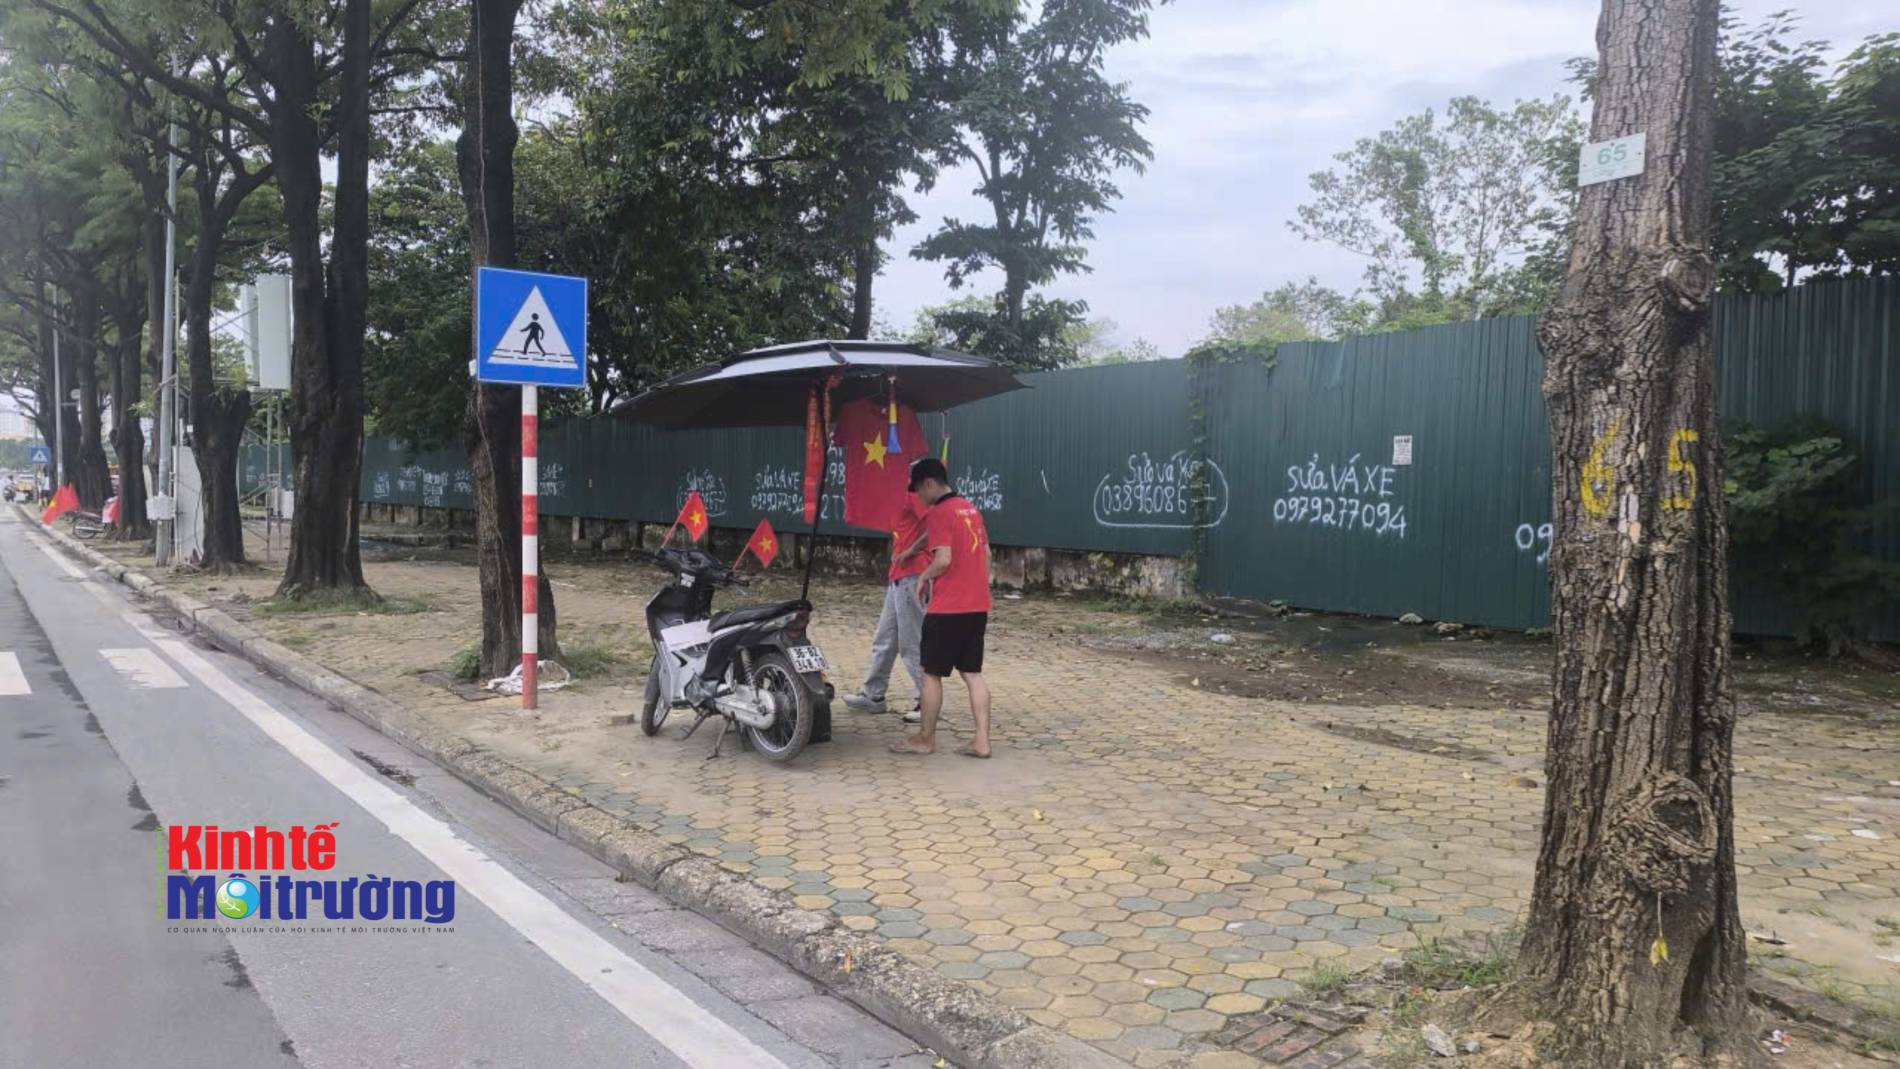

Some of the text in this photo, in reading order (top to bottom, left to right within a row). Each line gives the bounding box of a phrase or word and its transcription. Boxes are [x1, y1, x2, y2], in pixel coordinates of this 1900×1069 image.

[1598, 143, 1627, 165] 65
[1363, 464, 1396, 497] XE
[1580, 416, 1699, 516] 65
[1273, 496, 1407, 539] 0979277094
